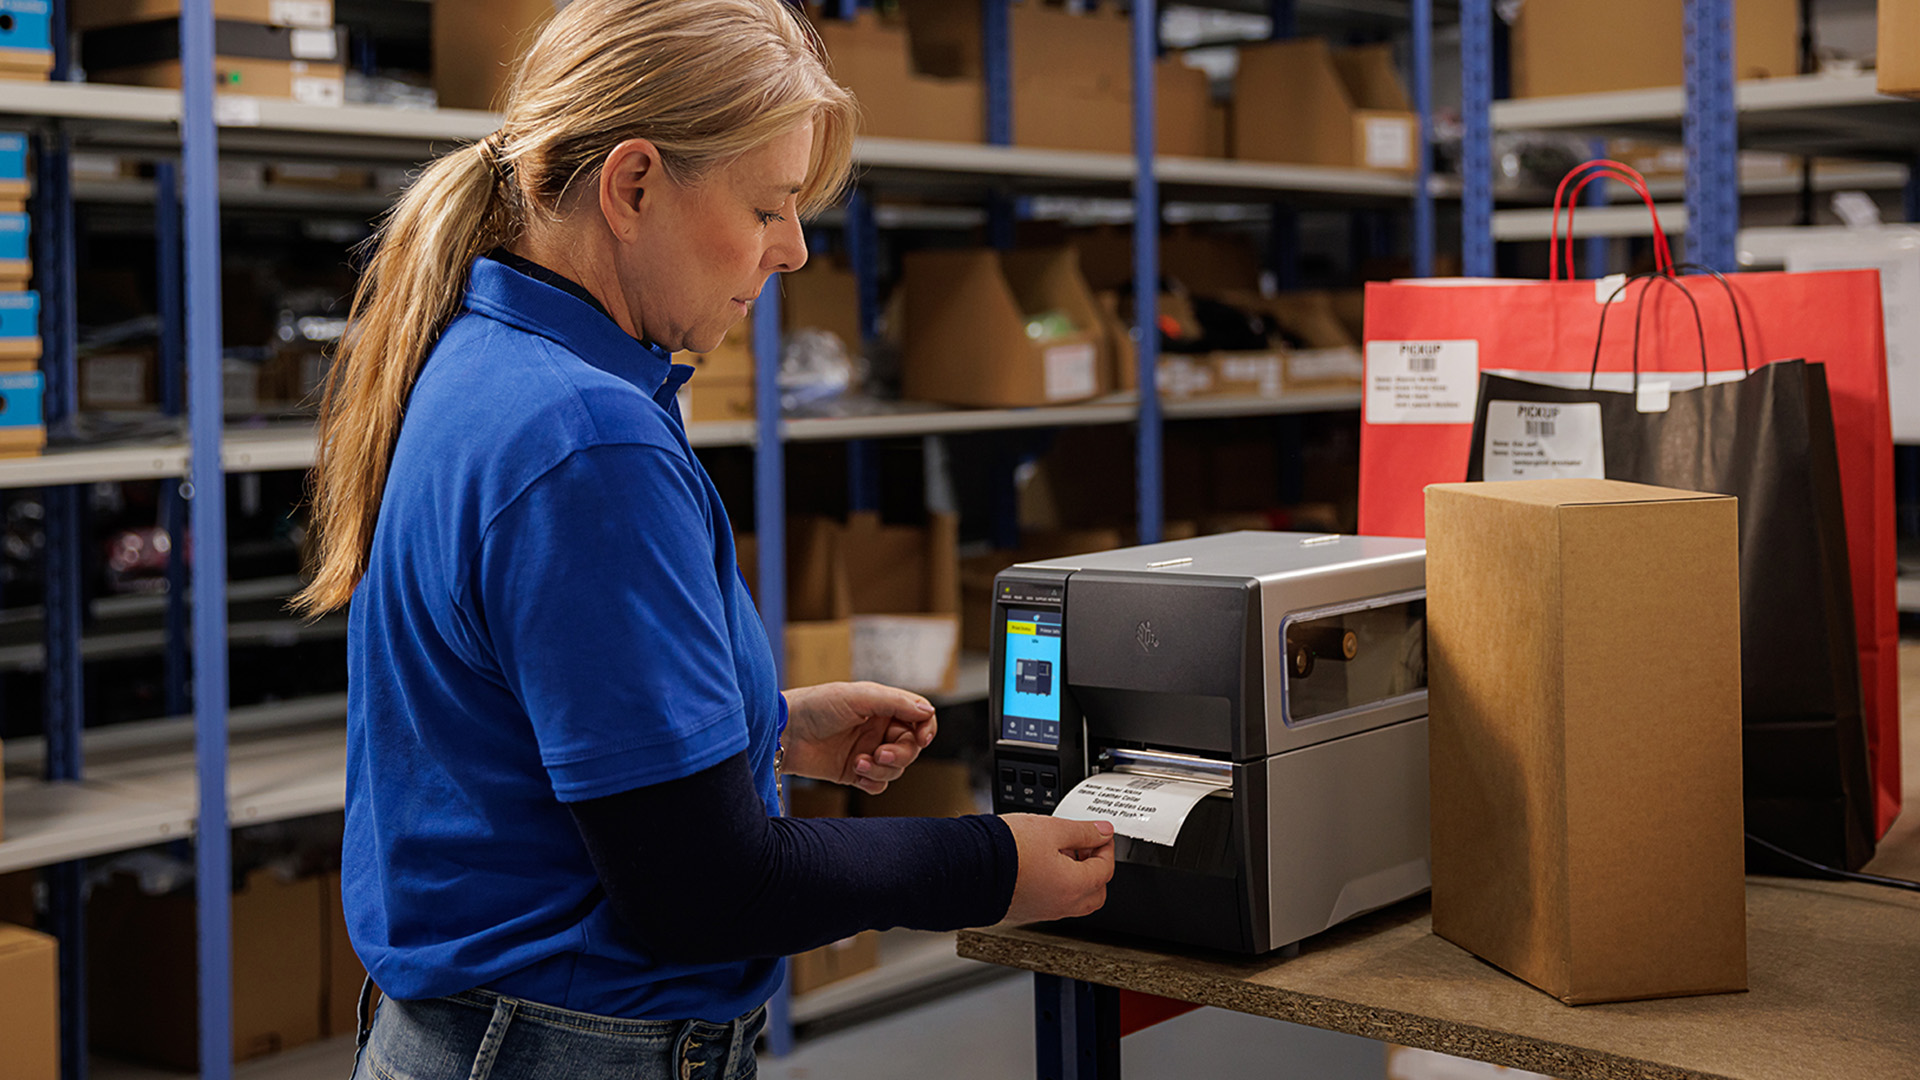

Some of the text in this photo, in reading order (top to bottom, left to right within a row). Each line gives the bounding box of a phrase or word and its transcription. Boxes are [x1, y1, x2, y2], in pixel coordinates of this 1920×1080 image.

[1400, 344, 1441, 355] PICKUP
[1517, 405, 1560, 418] PICKUP
[1098, 791, 1122, 799] Leather
[1087, 805, 1118, 817] Hedgehog
[1093, 798, 1157, 813] Spring Garden Leash
